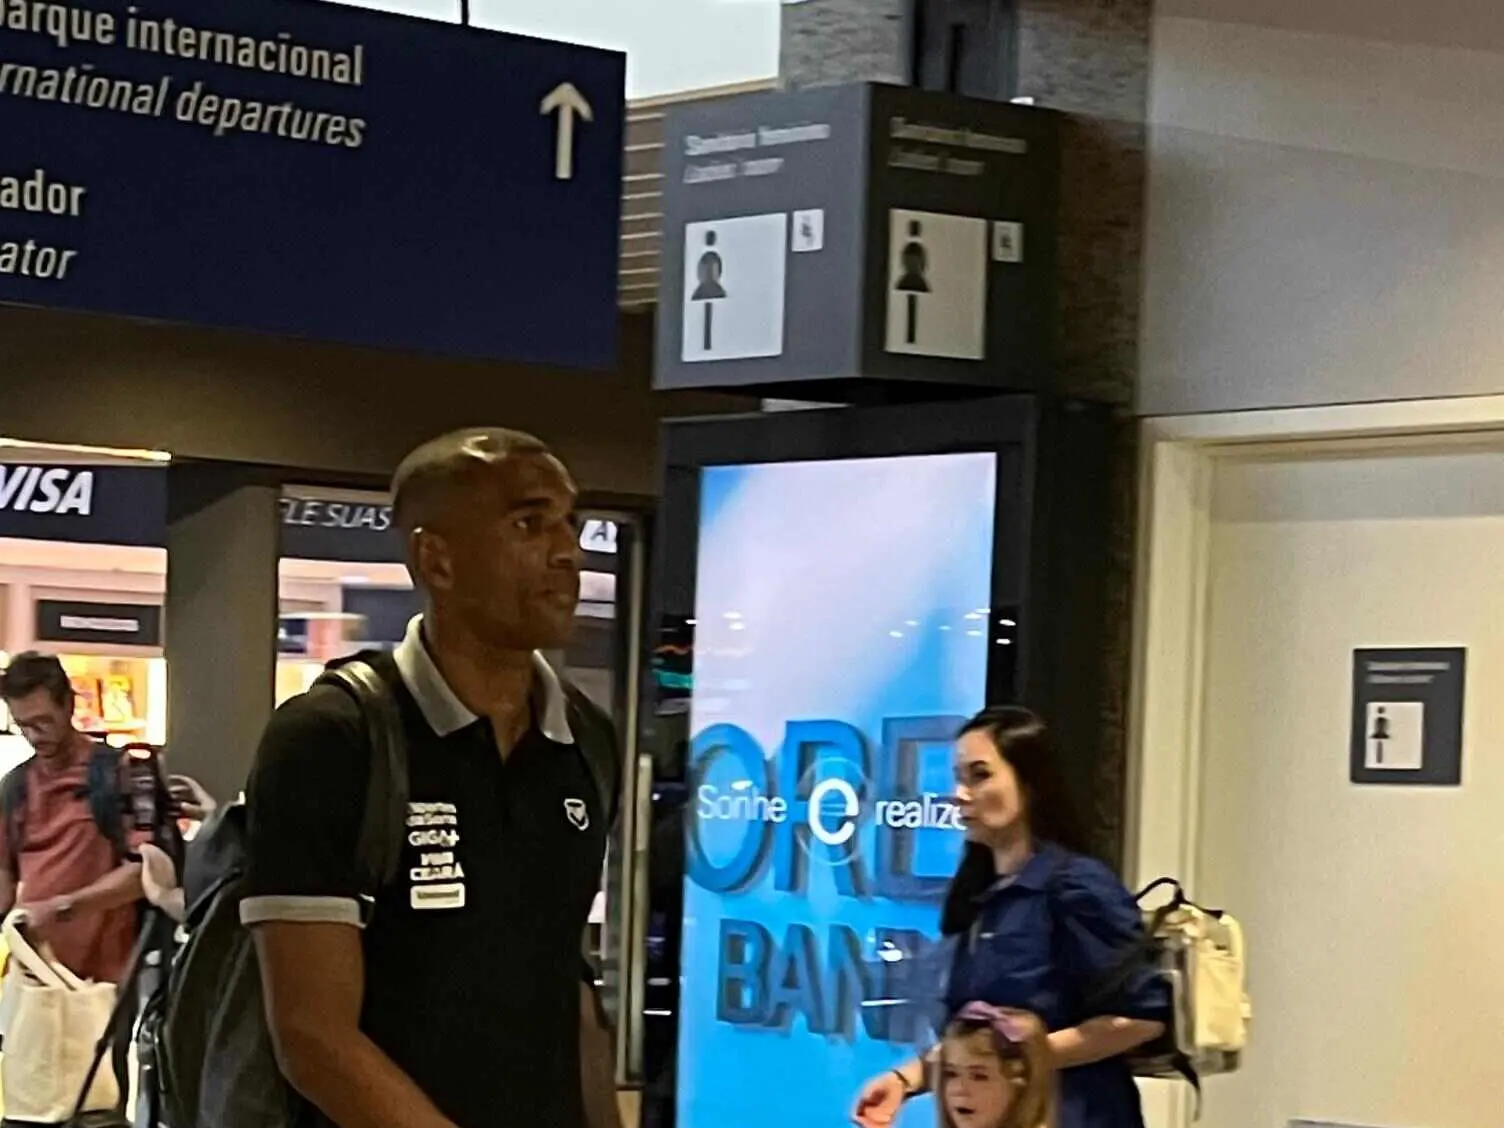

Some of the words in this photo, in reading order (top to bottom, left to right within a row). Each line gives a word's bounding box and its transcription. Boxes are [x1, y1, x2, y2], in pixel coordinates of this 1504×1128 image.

[126, 6, 363, 85] internacional
[175, 81, 366, 148] departures
[808, 777, 859, 846] e
